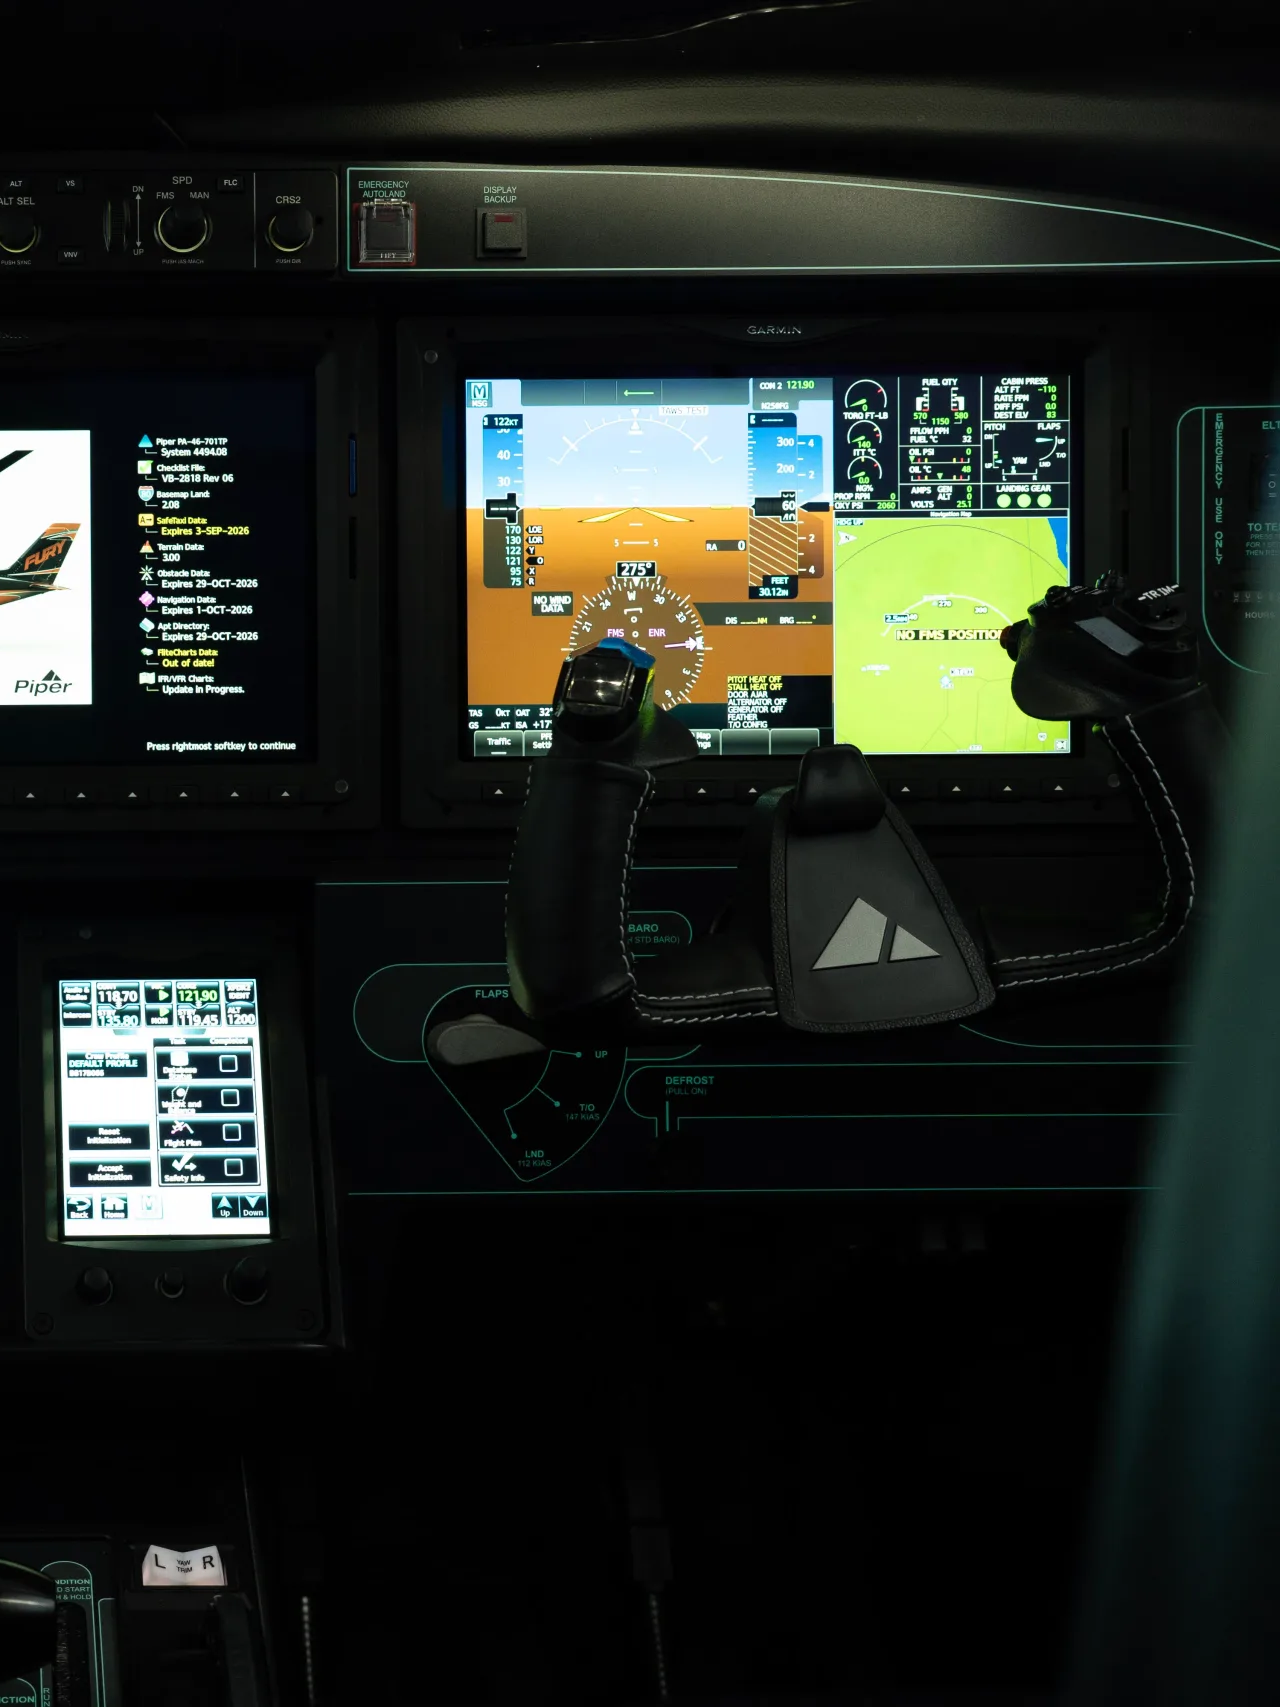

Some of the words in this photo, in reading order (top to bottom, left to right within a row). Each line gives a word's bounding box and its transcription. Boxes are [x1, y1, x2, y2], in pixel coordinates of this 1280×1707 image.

[172, 176, 193, 185] SPD
[223, 179, 238, 187] FLC
[358, 181, 409, 189] EMERGENCY
[362, 190, 406, 198] AUTOLAND
[483, 186, 517, 194] DISPLAY
[16, 196, 35, 206] SEL
[275, 195, 301, 204] CRS2
[746, 325, 802, 335] GARMIN
[786, 380, 815, 389] 121.90
[1037, 423, 1061, 431] FLAPS
[156, 438, 176, 446] Piper
[161, 448, 191, 458] System
[193, 448, 228, 456] 4494.08
[1214, 413, 1224, 490] EMERGENCY
[157, 464, 190, 472] Checklist
[191, 464, 205, 472] File:
[162, 474, 201, 482] VB-2818
[203, 474, 220, 482] Rev
[222, 474, 233, 482] 06
[996, 485, 1028, 493] LANDING
[1030, 485, 1051, 493] GEAR
[156, 490, 189, 499] Basemap
[190, 490, 210, 498] Land:
[162, 501, 180, 509] 2.08
[1214, 497, 1224, 523] USE
[157, 517, 187, 525] SafeTaxi
[188, 517, 207, 525] Data:
[161, 527, 193, 536] Expires
[196, 527, 249, 535] 3-SEP-2026
[1214, 531, 1224, 565] ONLY
[24, 539, 67, 571] FURY
[621, 562, 652, 576] 275°
[157, 596, 195, 604] Navigation
[197, 596, 216, 604] Data:
[533, 596, 547, 604] NO
[549, 596, 571, 604] WIND
[162, 606, 193, 615] Expires
[196, 606, 253, 614] 1-OCT-2026
[541, 604, 564, 613] DATA
[607, 629, 625, 637] FMS
[648, 629, 666, 637] ENR
[162, 658, 179, 667] Out
[181, 658, 190, 667] of
[193, 658, 215, 667] date!
[158, 675, 186, 683] IFR/VFR
[188, 675, 214, 683] Charts:
[14, 680, 72, 696] Piper
[162, 685, 193, 695] Update
[195, 685, 203, 693] in
[206, 685, 245, 695] Progress.
[728, 713, 758, 721] FEATHER
[146, 742, 170, 750] Press
[172, 742, 212, 752] rightmost
[214, 742, 246, 751] softkey
[248, 742, 257, 750] to
[260, 742, 296, 750] continue
[628, 924, 659, 933] BARO
[178, 990, 218, 1002] 121.90
[475, 990, 508, 999] FLAPS
[69, 1060, 103, 1068] DEFAULT
[105, 1060, 138, 1068] PROFILE
[665, 1076, 714, 1085] DEFROST
[525, 1150, 544, 1158] LND
[154, 1554, 167, 1570] L
[203, 1555, 214, 1569] R
[177, 1566, 193, 1574] TRIM
